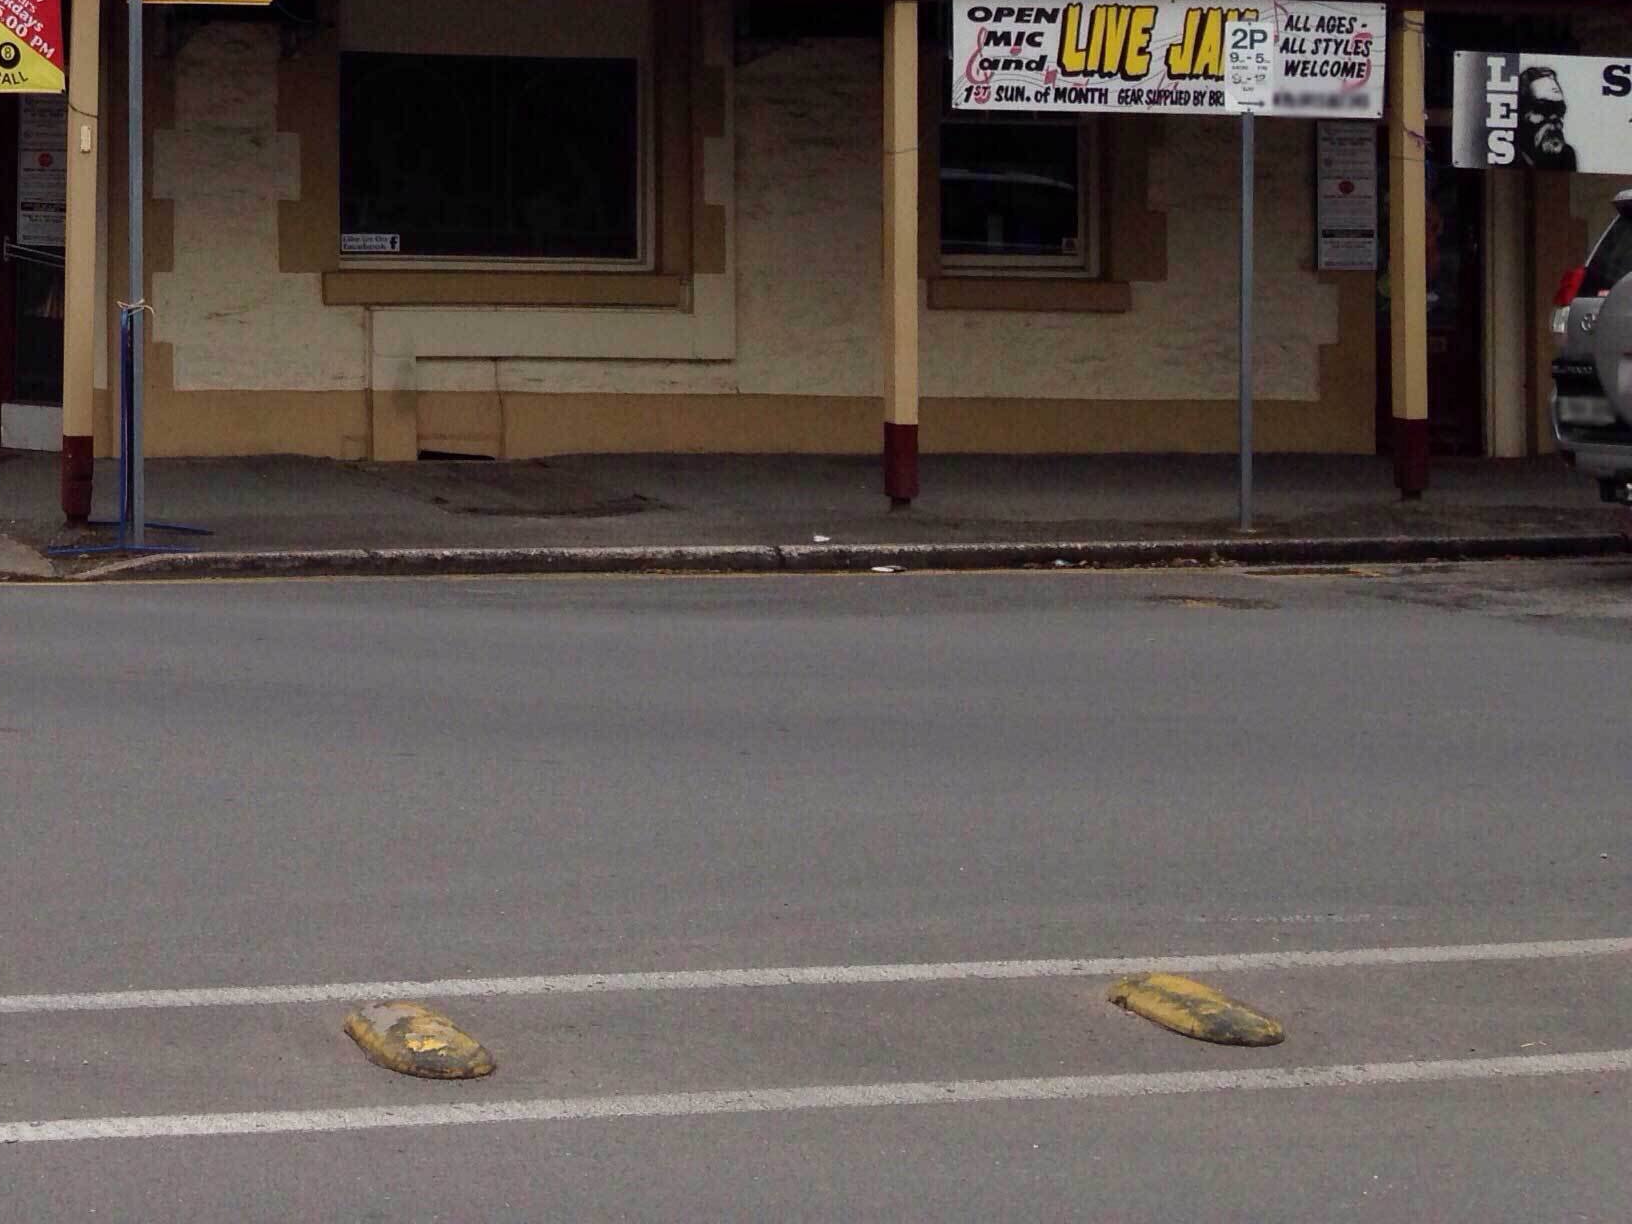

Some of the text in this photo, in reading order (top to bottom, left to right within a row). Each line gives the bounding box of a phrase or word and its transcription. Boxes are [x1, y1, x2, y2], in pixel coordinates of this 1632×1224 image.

[967, 6, 1060, 24] OPEN
[1284, 14, 1311, 32] ALL
[1317, 16, 1358, 34] AGES
[30, 35, 56, 59] PM
[983, 30, 1045, 48] MIC
[1057, 1, 1259, 82] LIVE JA
[1231, 28, 1268, 50] 2P
[1279, 37, 1373, 58] ALL STYLES
[978, 55, 1048, 72] and
[1284, 60, 1367, 79] WELCOME
[963, 85, 990, 103] 1ST
[994, 86, 1031, 103] SUN.
[1034, 88, 1051, 103] of
[1054, 87, 1108, 104] MONTH
[1118, 89, 1143, 105] GEAR
[1145, 89, 1191, 106] SUPPLIED
[1192, 90, 1208, 107] BY
[1486, 57, 1518, 164] LES
